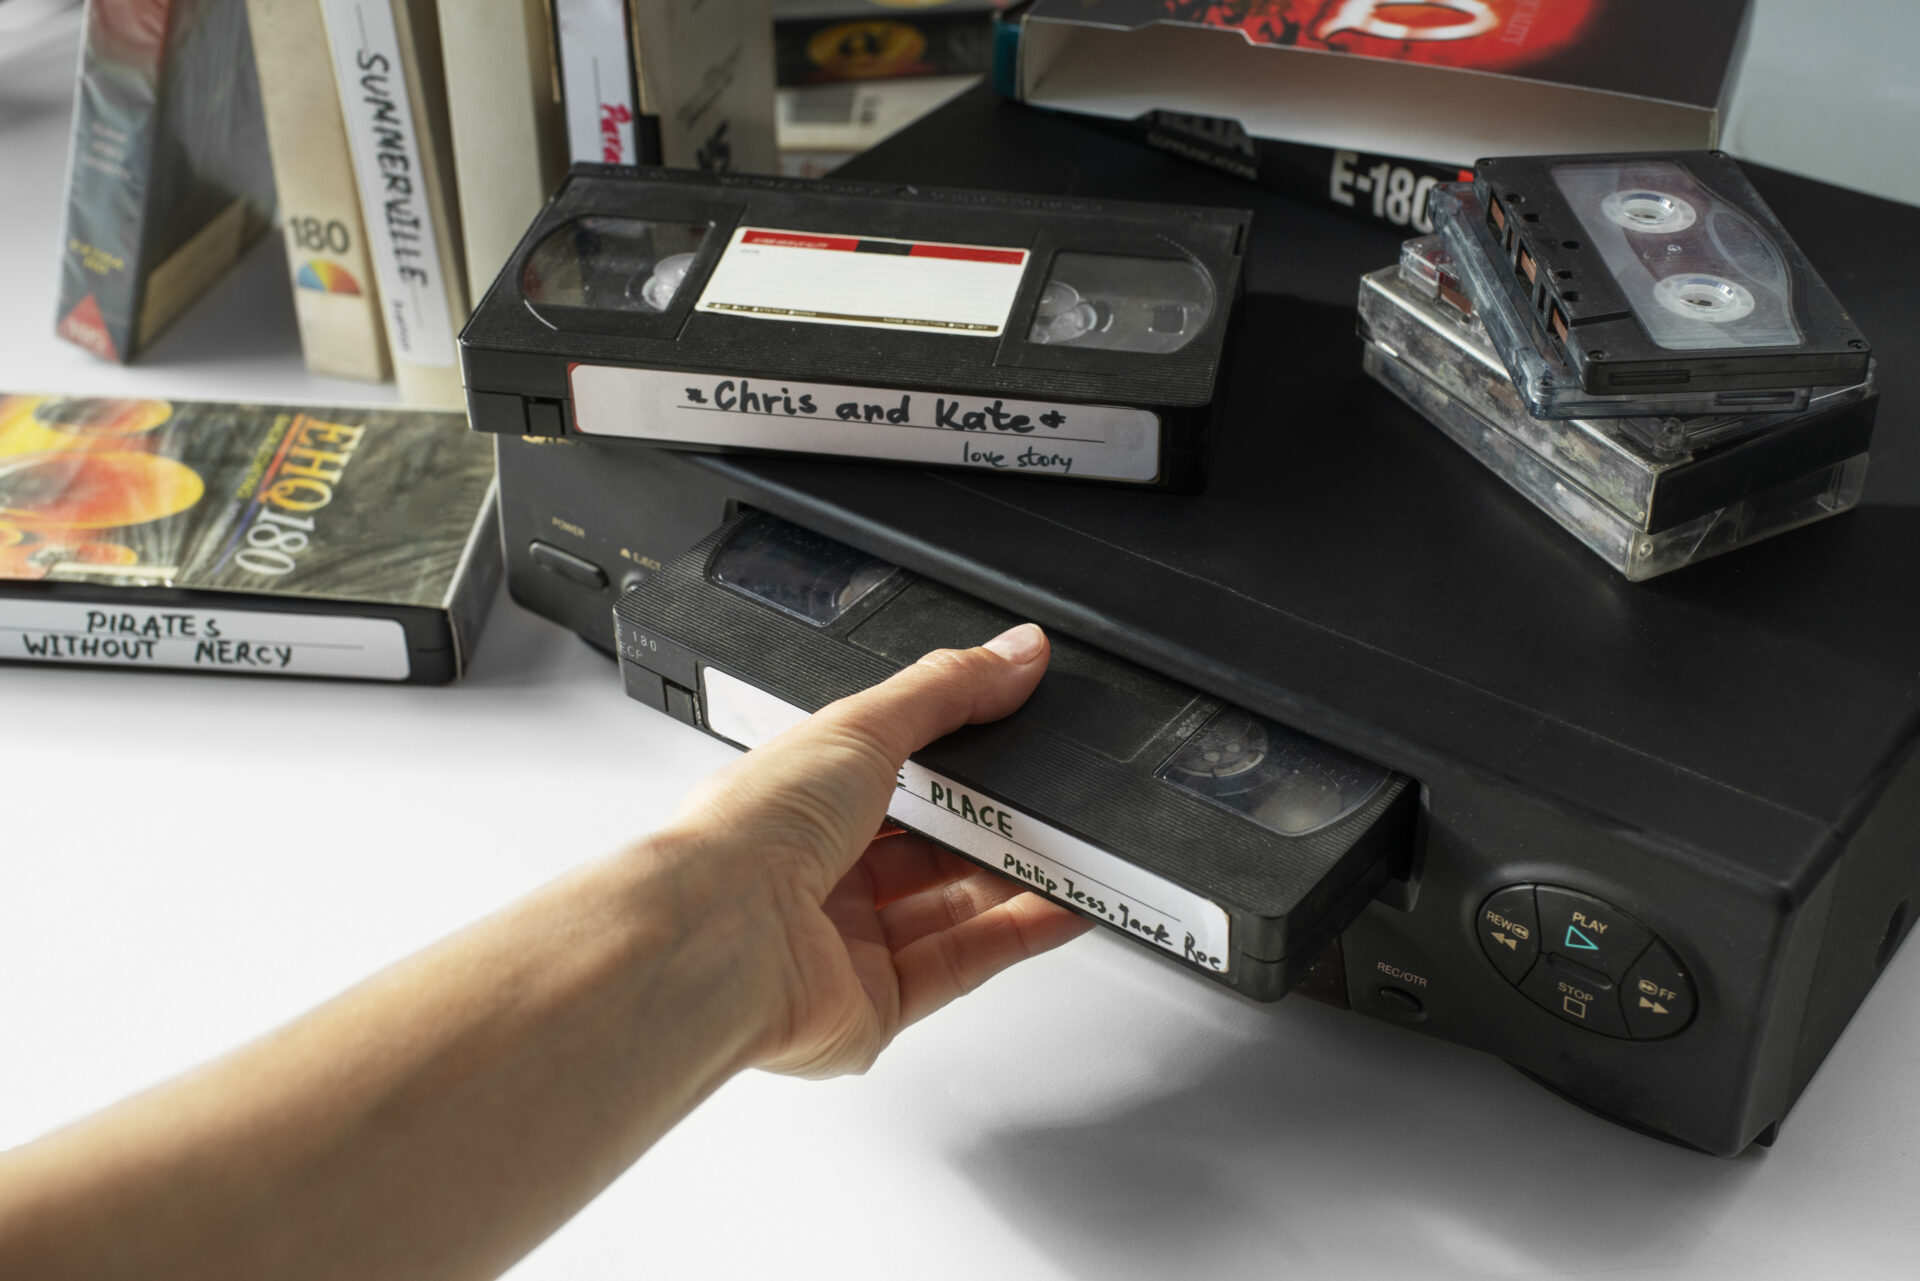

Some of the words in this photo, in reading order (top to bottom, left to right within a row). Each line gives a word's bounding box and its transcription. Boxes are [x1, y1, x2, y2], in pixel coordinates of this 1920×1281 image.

[289, 216, 350, 255] 180
[835, 394, 910, 426] and
[935, 397, 1036, 433] Kate
[256, 416, 367, 512] EHQ
[962, 441, 1006, 468] love
[1016, 445, 1073, 474] story
[235, 506, 316, 576] 180
[552, 516, 585, 538] POWER
[633, 552, 661, 571] EJECT
[86, 610, 221, 638] PIRATES
[22, 633, 159, 660] WITHOUT
[633, 631, 657, 652] 180
[930, 780, 1013, 839] PLACE
[1003, 852, 1058, 893] Philip
[1486, 910, 1513, 931] REW
[1572, 911, 1608, 935] PLAY
[1376, 961, 1428, 989] REC/OTR
[1557, 981, 1594, 1004] STOP
[1659, 988, 1677, 1002] FF
